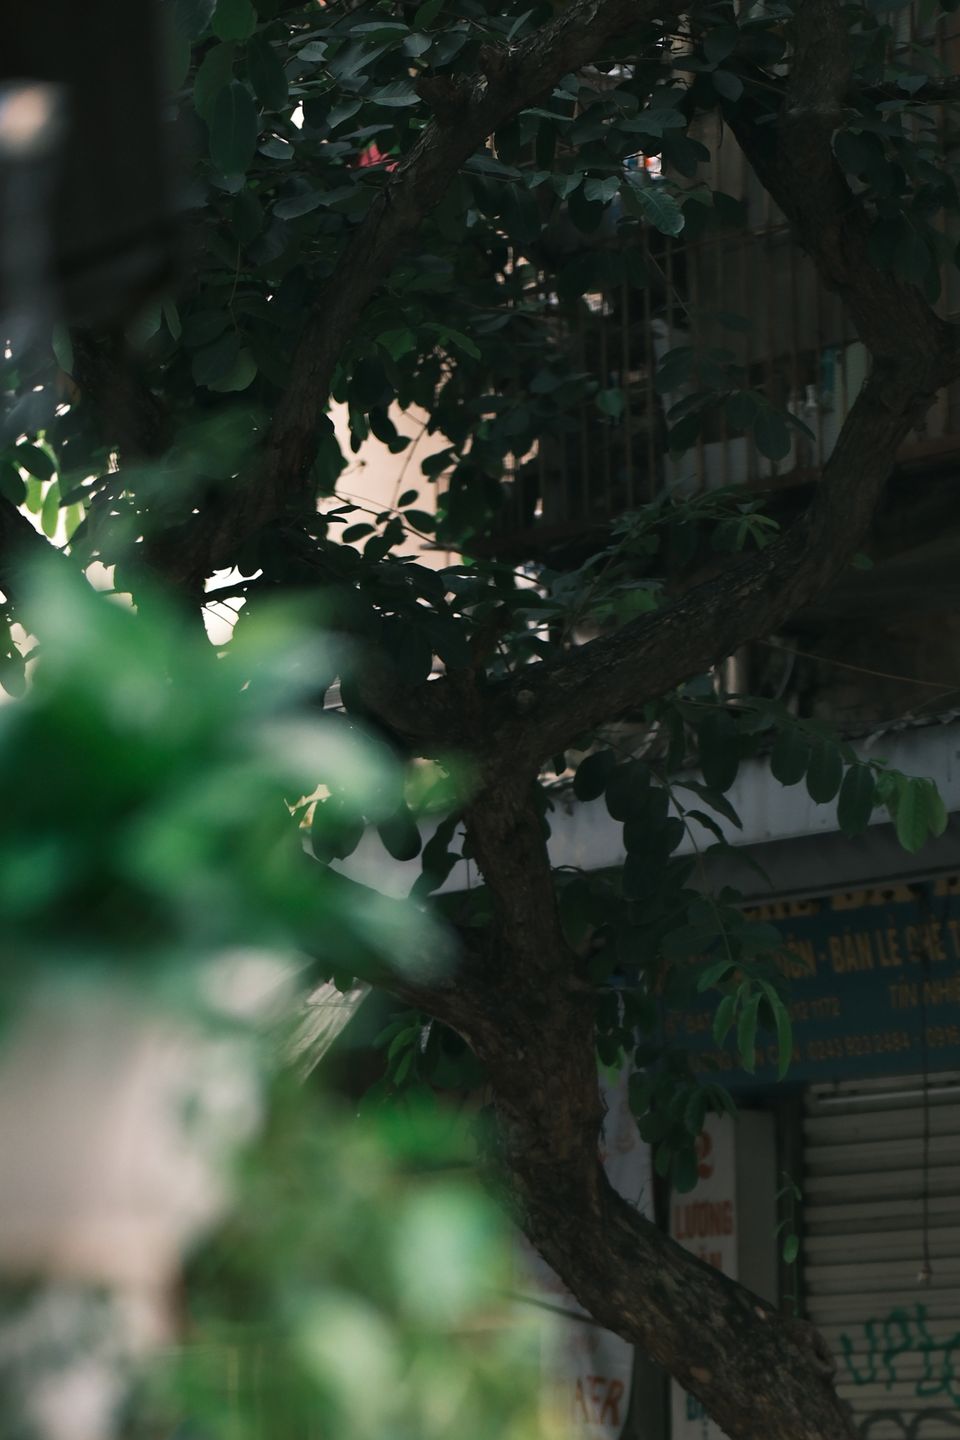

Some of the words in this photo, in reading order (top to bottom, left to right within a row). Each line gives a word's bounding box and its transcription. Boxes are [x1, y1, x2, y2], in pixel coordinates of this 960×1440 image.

[828, 928, 874, 974] BÁN
[876, 912, 902, 966] LẺ
[905, 913, 947, 962] CHÈ
[889, 973, 918, 1009] TÍN
